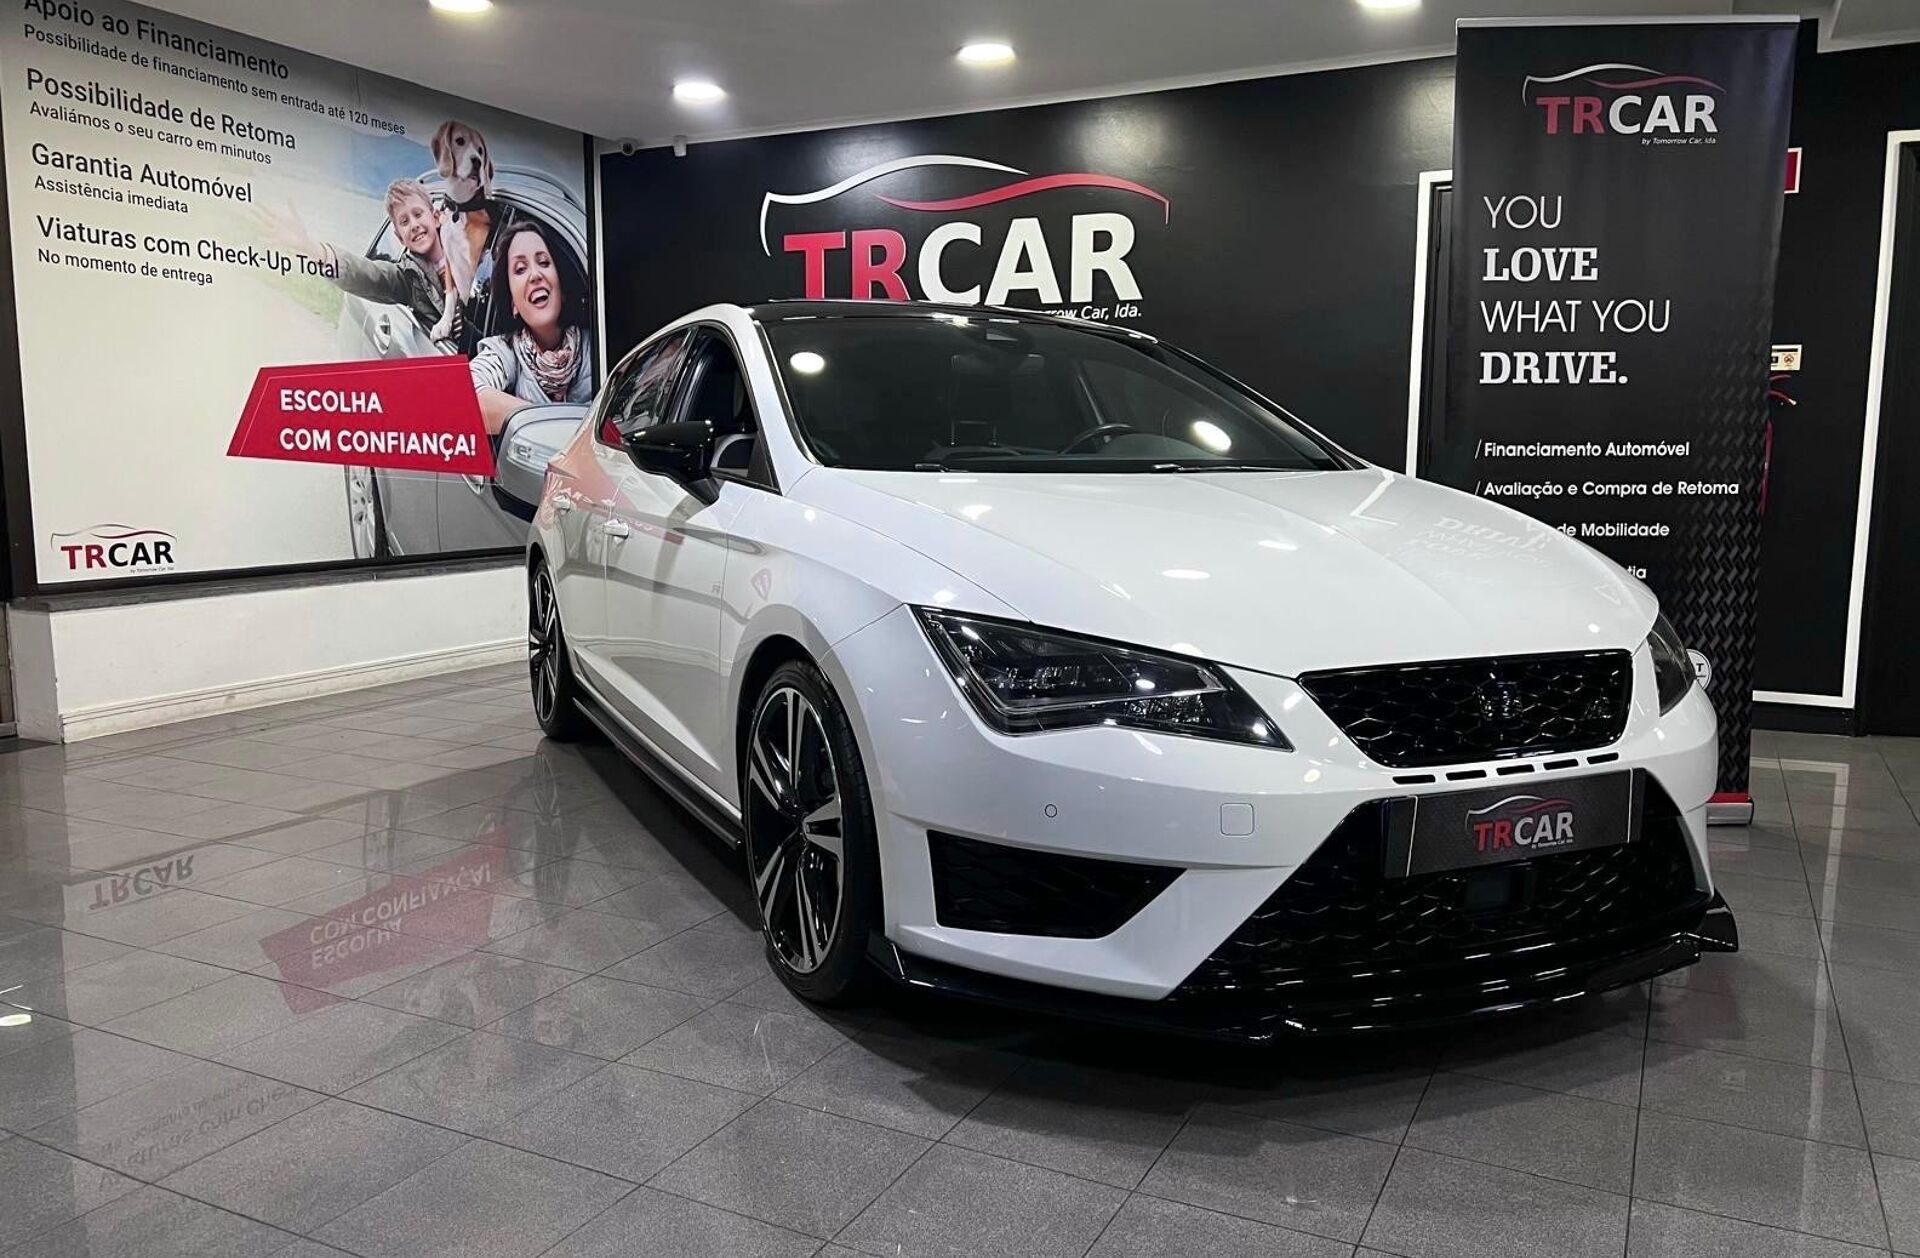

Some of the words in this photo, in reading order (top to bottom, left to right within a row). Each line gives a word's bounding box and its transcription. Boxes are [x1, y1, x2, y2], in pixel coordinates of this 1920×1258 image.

[24, 0, 95, 27] Apoio
[102, 15, 130, 36] ao
[138, 19, 289, 80] Financiamento
[24, 24, 128, 63] Possibilidade
[131, 51, 149, 68] de
[153, 57, 248, 94] financiamento
[251, 86, 278, 102] sem
[281, 93, 325, 115] entrada
[328, 104, 346, 120] até
[349, 110, 368, 125] 120
[371, 117, 406, 136] meses
[27, 68, 184, 124] Possibilidade
[190, 108, 216, 131] de
[222, 114, 296, 150] Retoma
[1536, 95, 1719, 135] TRCAR
[30, 101, 110, 130] Avaliámos
[114, 121, 124, 133] o
[128, 124, 153, 139] seu
[157, 130, 193, 148] carro
[197, 139, 217, 153] em
[221, 145, 272, 165] minutos
[32, 143, 133, 181] Garantia
[140, 163, 252, 203] Automóvel
[34, 175, 123, 202] Assistência
[127, 190, 189, 213] imediata
[1483, 195, 1562, 229] YOU
[36, 215, 137, 249] Viaturas
[143, 235, 190, 257] com
[197, 239, 292, 276] Check-Up
[296, 254, 339, 279] Total
[783, 212, 1143, 306] TRCAR
[1482, 247, 1598, 282] LOVE
[38, 248, 60, 264] No
[65, 254, 137, 275] momento
[140, 261, 158, 277] de
[162, 267, 213, 286] entrega
[1080, 305, 1109, 321] Car,
[1480, 300, 1582, 333] WHAT
[1592, 299, 1670, 333] YOU
[1479, 351, 1628, 384] DRIVE.
[280, 389, 383, 414] ESCOLHA
[279, 428, 331, 451] COM
[337, 430, 476, 462] CONFIANÇA!
[1605, 440, 1690, 457] Automóvel
[1567, 485, 1578, 496] e
[1582, 481, 1647, 498] Compra
[1652, 481, 1673, 496] de
[1677, 481, 1739, 496] Retoma
[1581, 523, 1670, 537] Mobilidade
[61, 541, 175, 570] TRCAR
[1474, 811, 1575, 852] TRCAR
